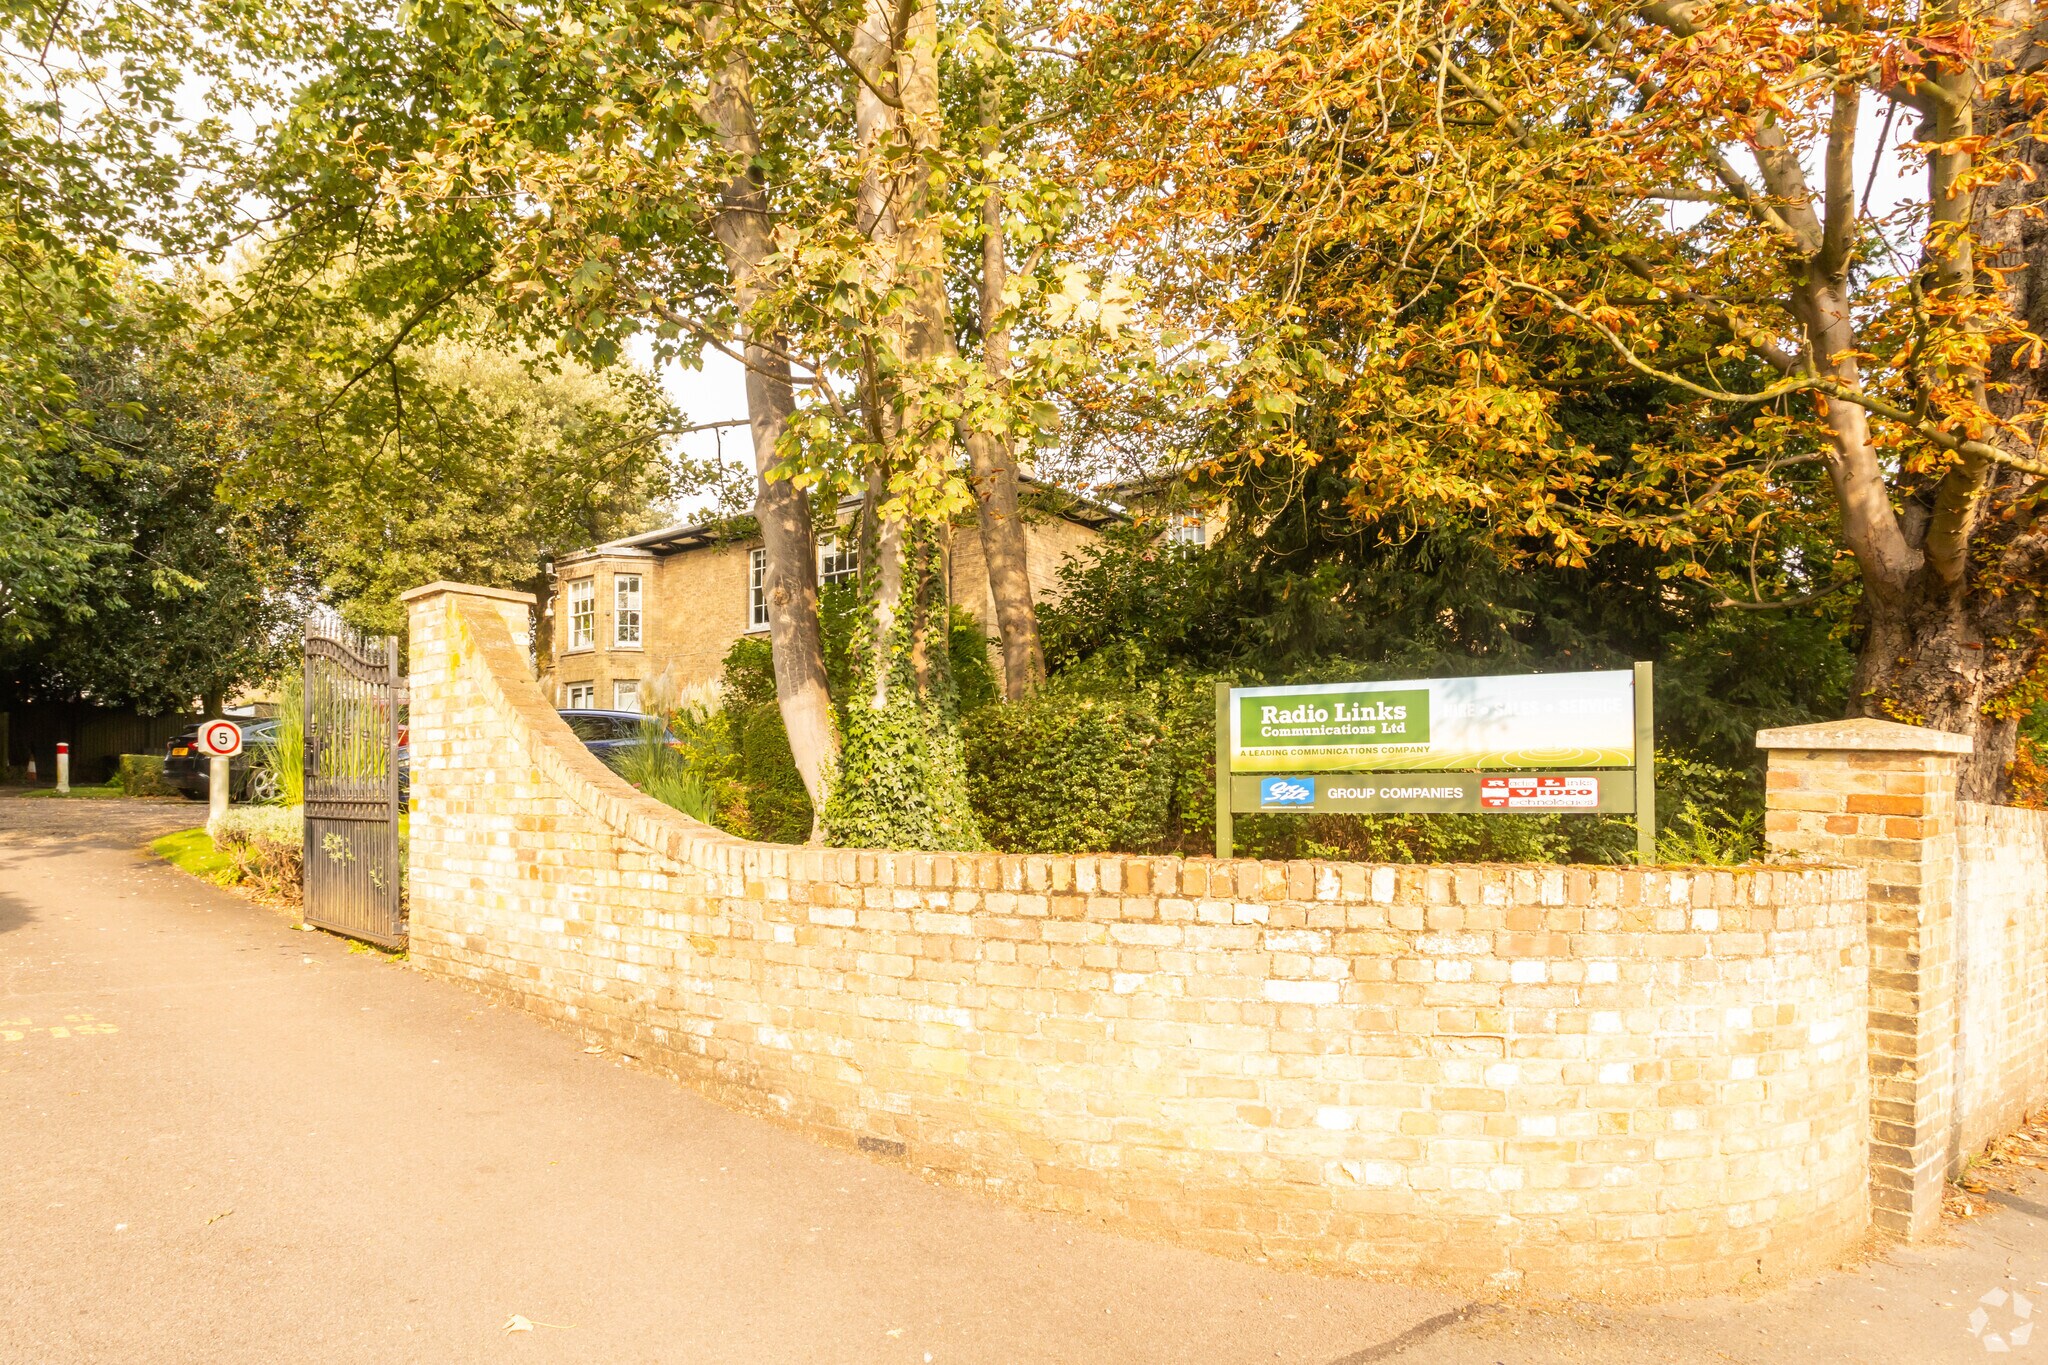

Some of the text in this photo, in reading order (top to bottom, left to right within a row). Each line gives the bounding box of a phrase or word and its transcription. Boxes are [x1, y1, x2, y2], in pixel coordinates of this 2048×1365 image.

[1261, 701, 1407, 724] Radio Links
[1261, 722, 1407, 737] Communications Ltd
[219, 732, 228, 745] 5
[1249, 749, 1288, 757] LEADING
[1291, 747, 1379, 756] COMMUNICATIONS
[1381, 746, 1430, 754] COMPANY
[1487, 779, 1593, 787] Radio Links
[1327, 787, 1464, 799] GROUP COMPANIES
